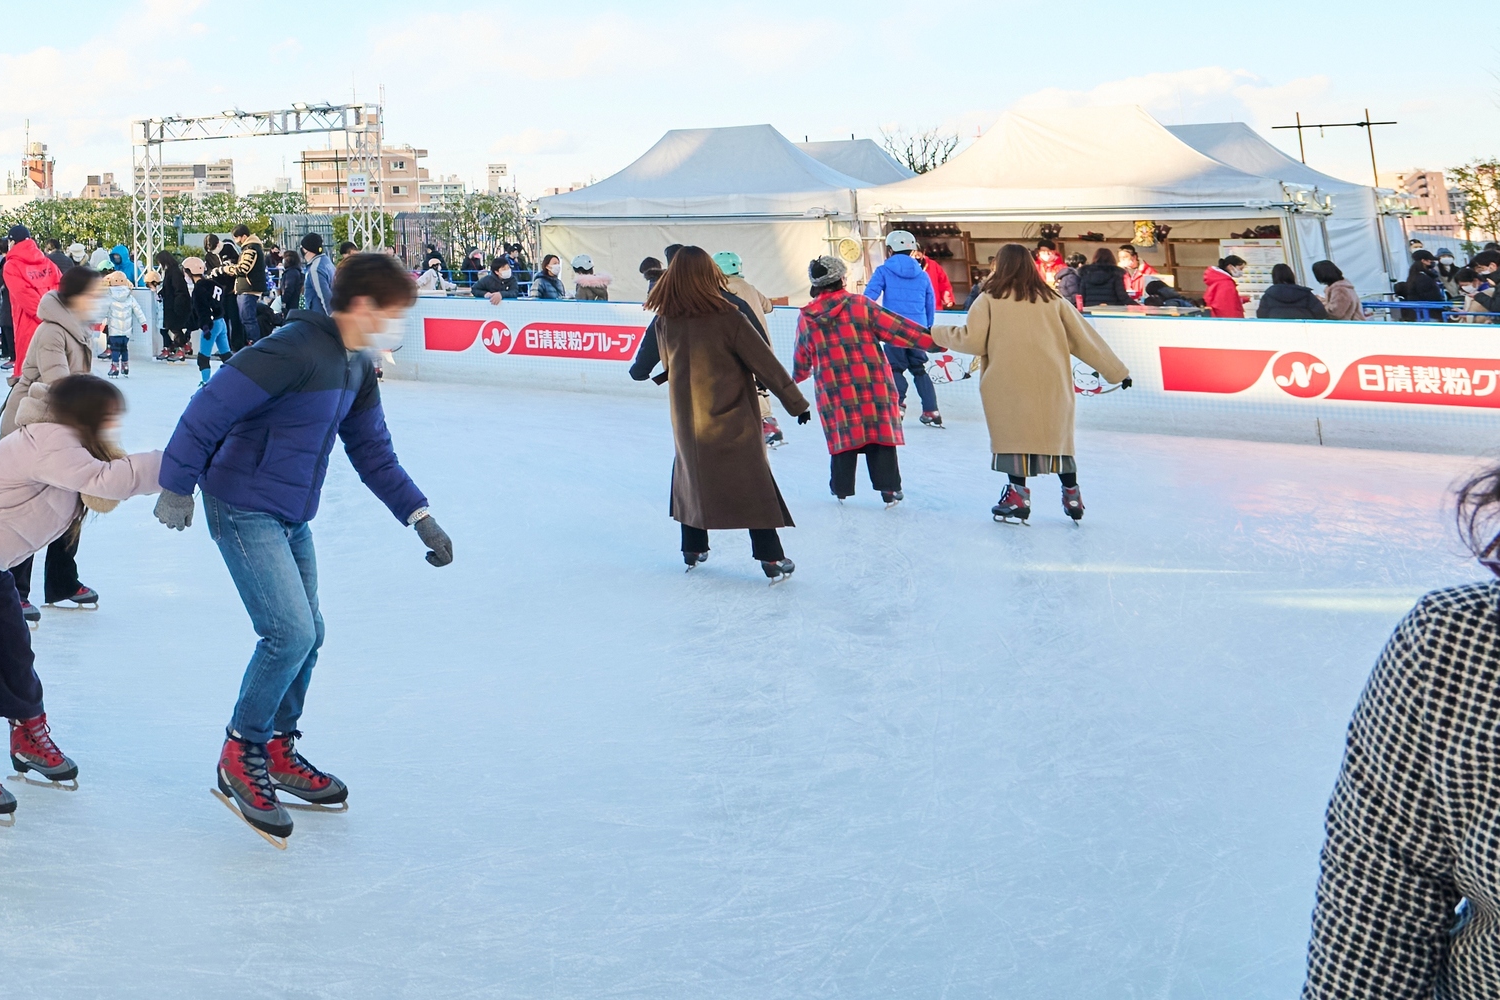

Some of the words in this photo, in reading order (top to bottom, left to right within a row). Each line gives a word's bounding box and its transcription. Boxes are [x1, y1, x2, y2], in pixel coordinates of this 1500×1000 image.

[212, 285, 223, 301] R
[525, 328, 636, 353] 日清製粉グループ
[1357, 363, 1500, 397] 日清製粉グ
